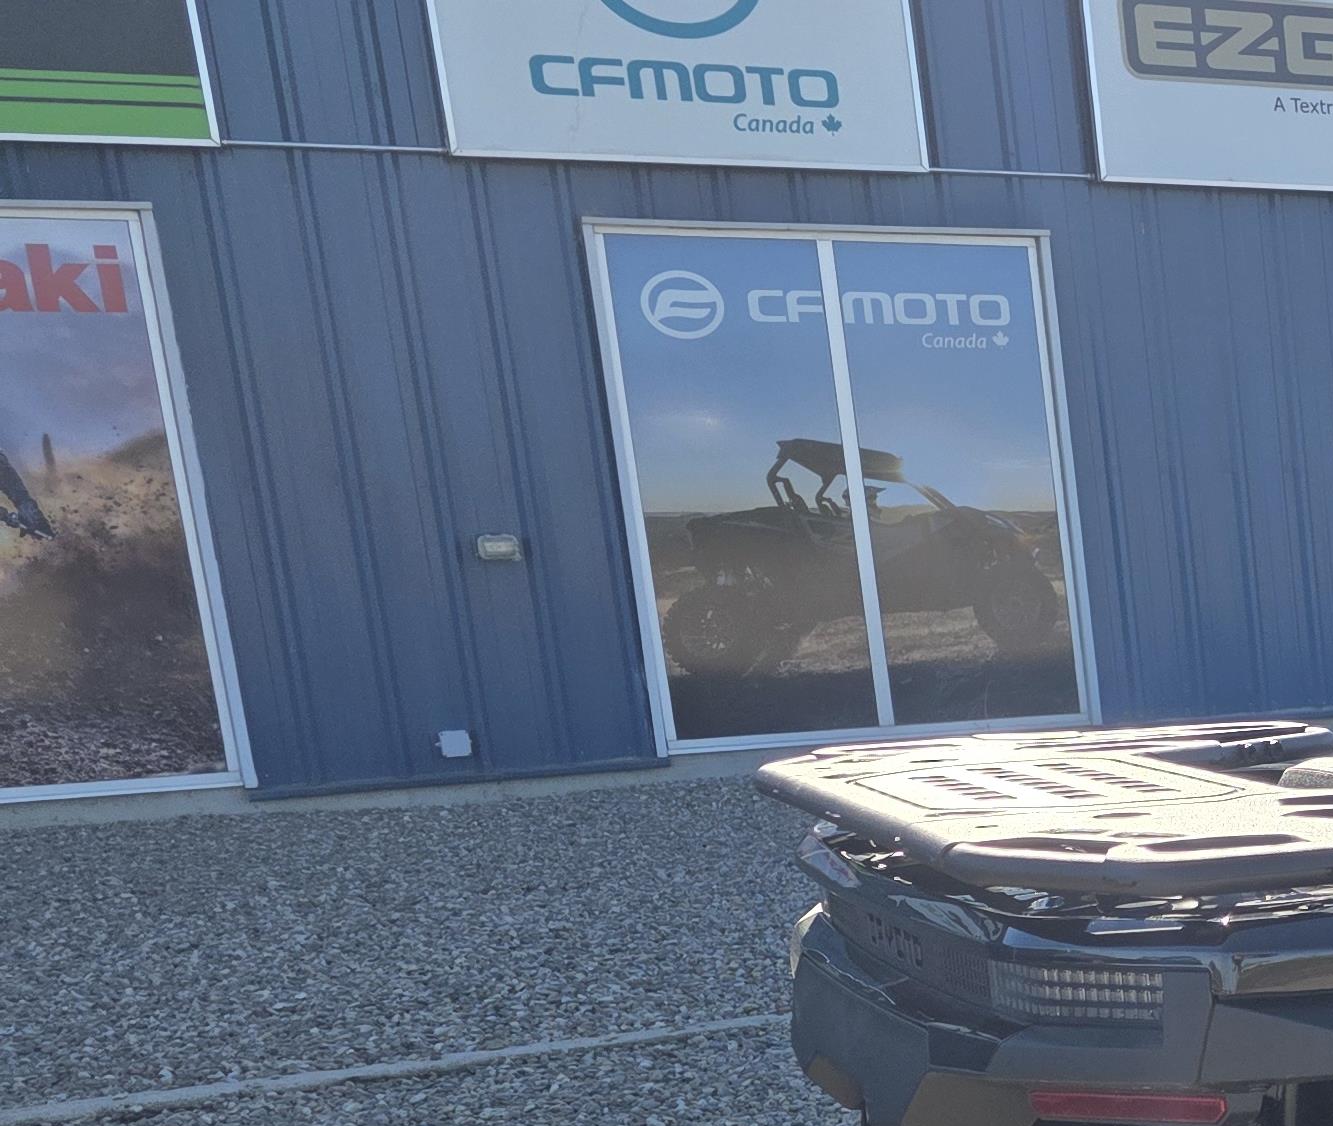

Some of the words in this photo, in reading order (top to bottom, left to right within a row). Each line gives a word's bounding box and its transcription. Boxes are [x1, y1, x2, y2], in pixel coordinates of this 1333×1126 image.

[529, 54, 839, 108] CFMOTO
[1273, 97, 1286, 112] A
[733, 113, 815, 135] Canada
[922, 332, 988, 350] Canada
